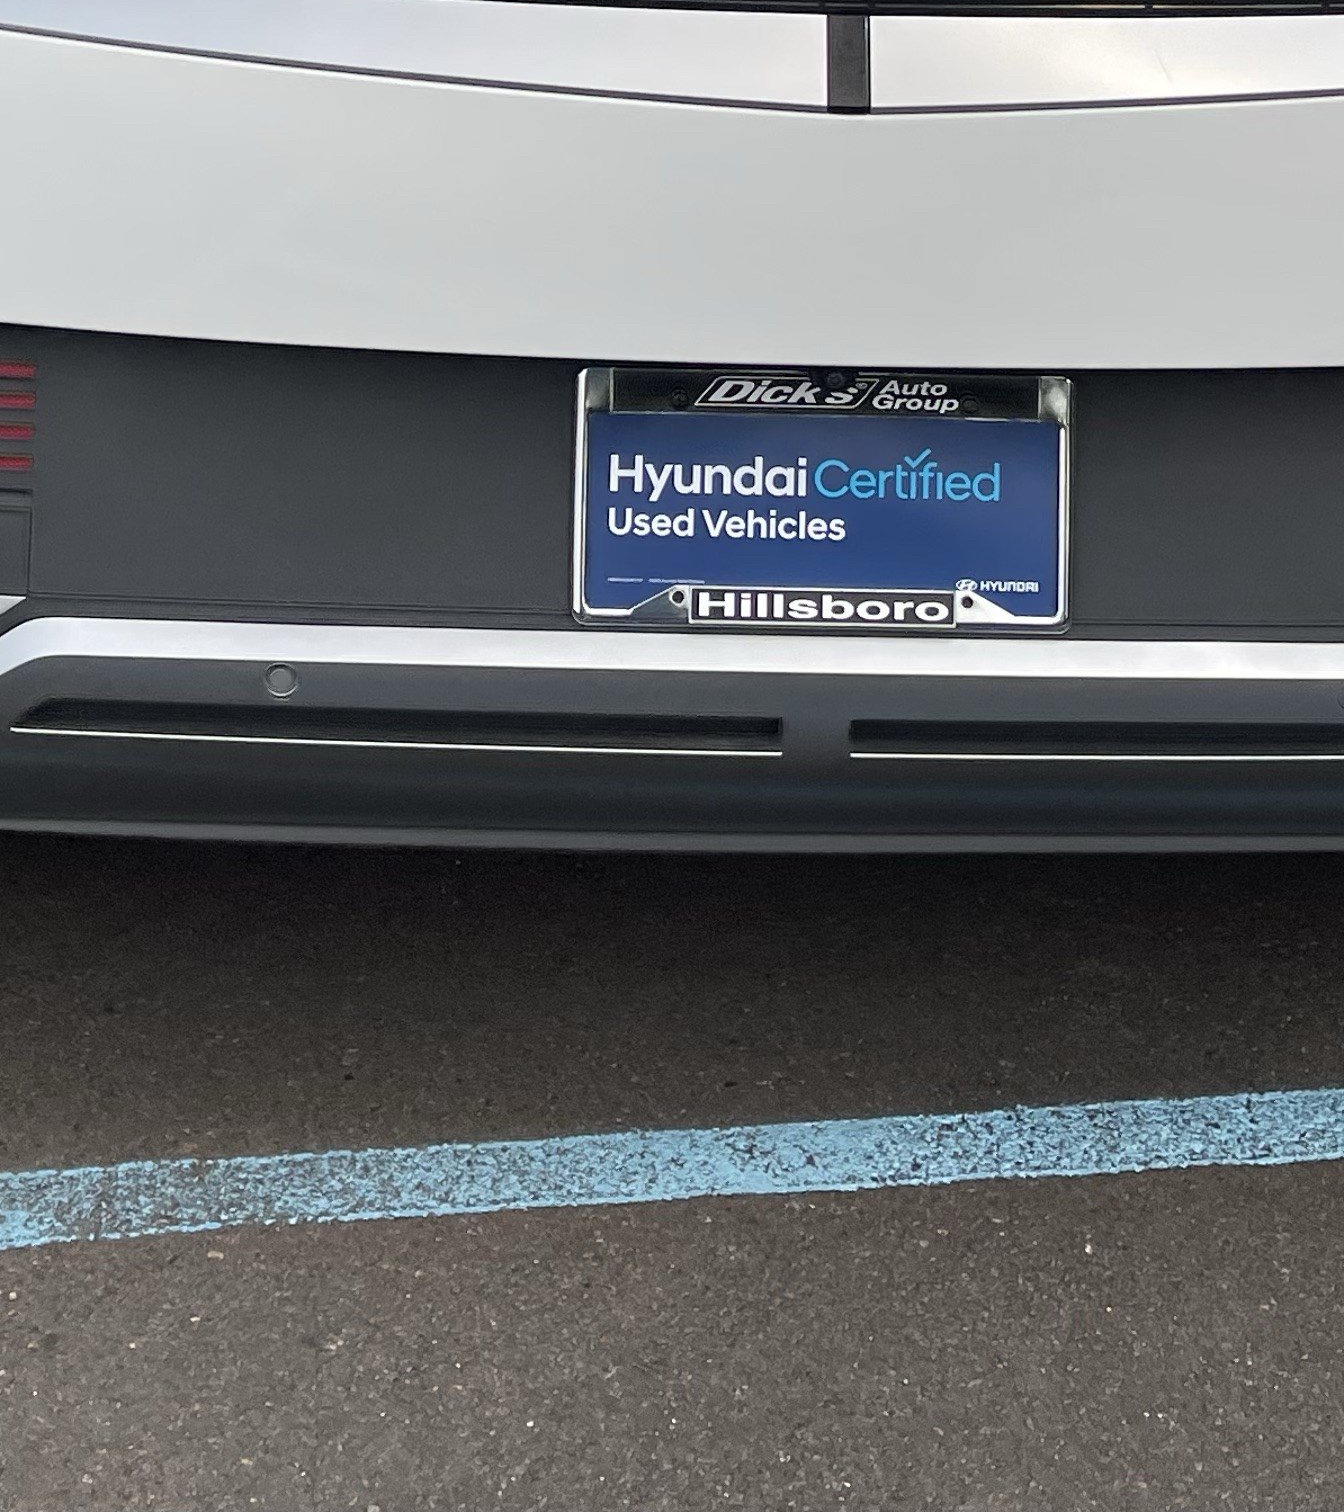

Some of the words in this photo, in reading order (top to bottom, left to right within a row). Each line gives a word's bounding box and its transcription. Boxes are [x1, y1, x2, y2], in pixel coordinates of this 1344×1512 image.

[708, 378, 858, 405] Dicks
[878, 380, 948, 397] Auto
[872, 395, 960, 414] Group
[608, 454, 807, 503] Hyundai
[814, 449, 1001, 502] Certified
[608, 508, 695, 538] Used
[702, 510, 846, 541] Vehicles
[979, 580, 1040, 594] HYUNDAI
[698, 593, 950, 622] Hillsboro
